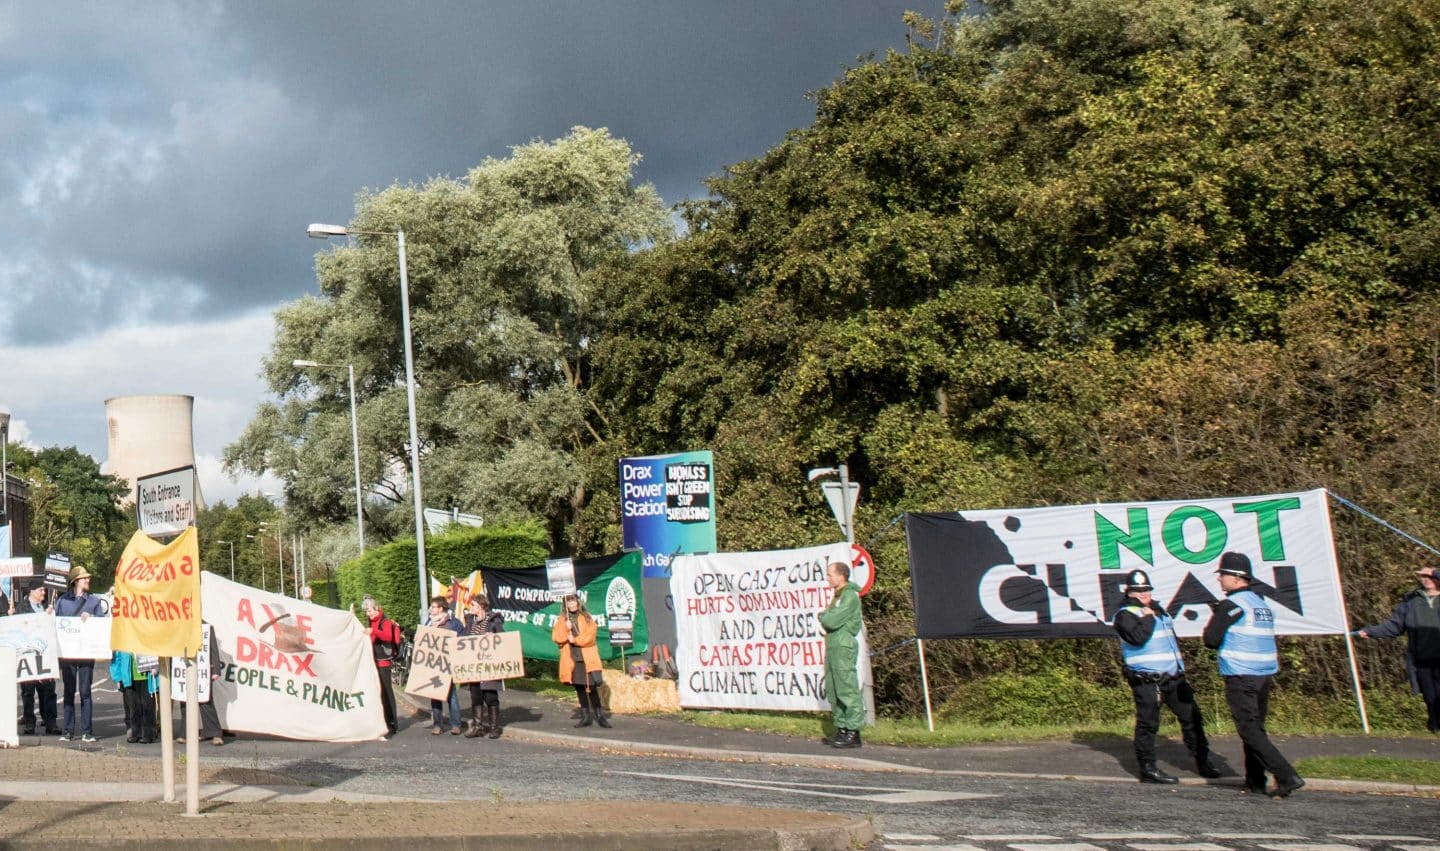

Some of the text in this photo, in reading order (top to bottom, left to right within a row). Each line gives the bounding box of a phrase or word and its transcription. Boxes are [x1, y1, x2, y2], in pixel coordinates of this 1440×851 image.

[623, 465, 652, 480] Drax
[142, 484, 180, 504] South Entrance
[624, 483, 664, 498] Power
[164, 505, 174, 522] and
[625, 499, 667, 516] Station
[1094, 496, 1301, 570] NOT
[179, 555, 193, 576] a
[694, 573, 735, 595] OPEN
[738, 567, 786, 592] CAST
[498, 586, 511, 599] NO
[687, 587, 836, 616] HURTS COMMUNITIE
[111, 594, 139, 618] ead
[236, 598, 315, 646] AXE
[533, 613, 545, 626] OF
[720, 619, 755, 640] AND
[418, 632, 452, 655] AXE
[456, 634, 502, 652] STOP
[236, 636, 318, 678] DRAX
[413, 650, 452, 675] DRAX
[477, 651, 493, 661] the
[699, 641, 825, 667] CATASTROPHI
[17, 655, 51, 678] AL
[173, 667, 208, 679] DEH
[453, 660, 520, 675] GREENWASH
[220, 661, 365, 712] PEOPLE & PLANET
[689, 671, 827, 701] CLIMATE CHANG
